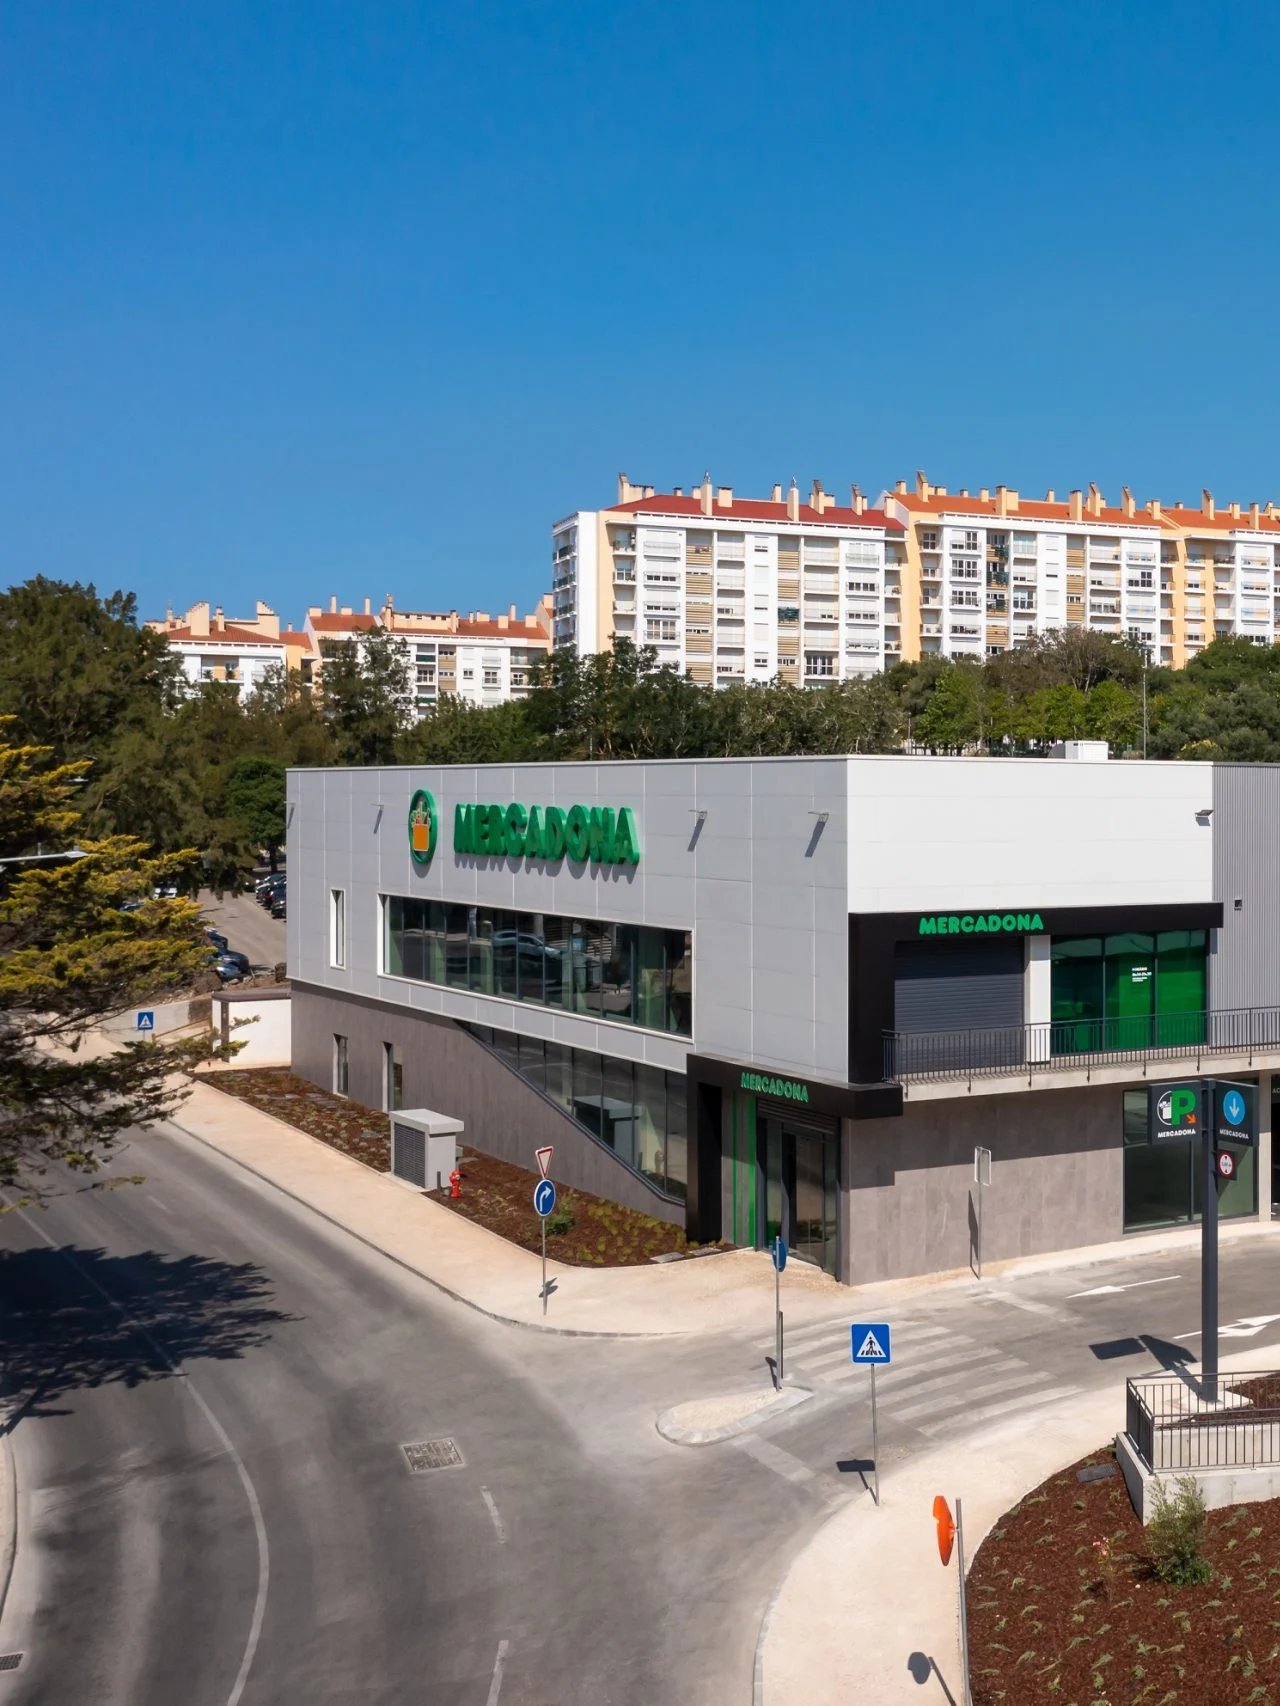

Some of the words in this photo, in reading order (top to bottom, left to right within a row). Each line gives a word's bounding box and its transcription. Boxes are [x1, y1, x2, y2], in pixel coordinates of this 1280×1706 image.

[453, 803, 640, 865] MERCADONA
[919, 914, 1043, 934] MERCADONA
[741, 1072, 808, 1102] MERCADONA
[1171, 1089, 1196, 1125] P
[1157, 1128, 1196, 1138] MERCADONA
[1219, 1128, 1249, 1139] MERCADONA
